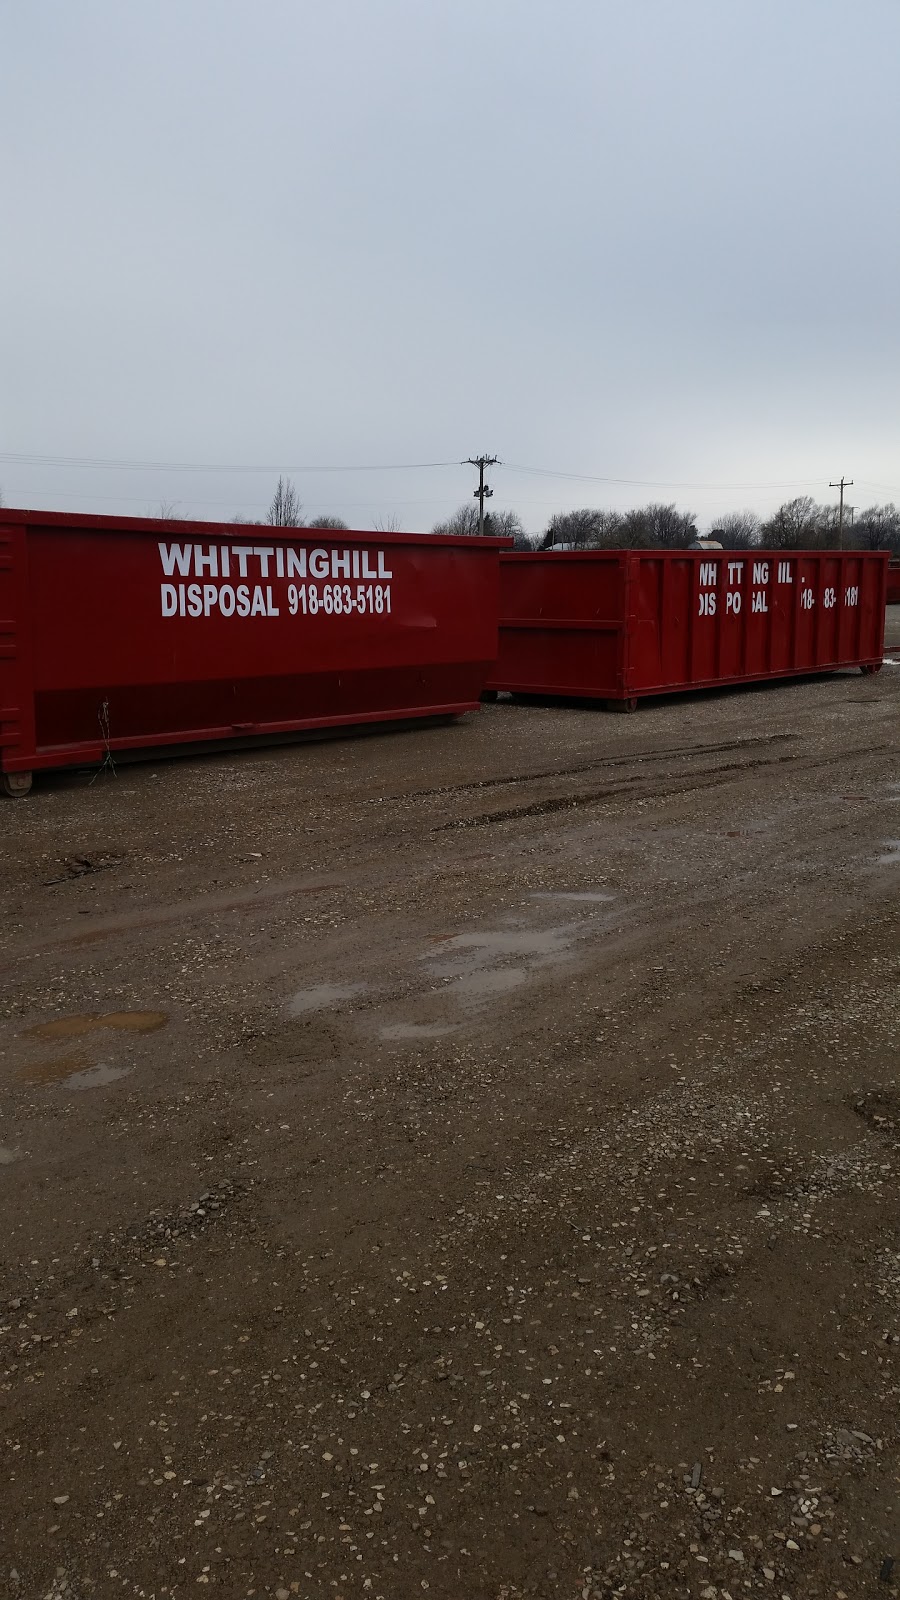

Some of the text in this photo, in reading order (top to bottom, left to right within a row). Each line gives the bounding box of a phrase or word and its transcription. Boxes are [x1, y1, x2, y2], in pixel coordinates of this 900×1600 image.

[158, 542, 393, 579] WHITTINGHILL
[160, 583, 392, 617] DISPOSAL 918-683-5181
